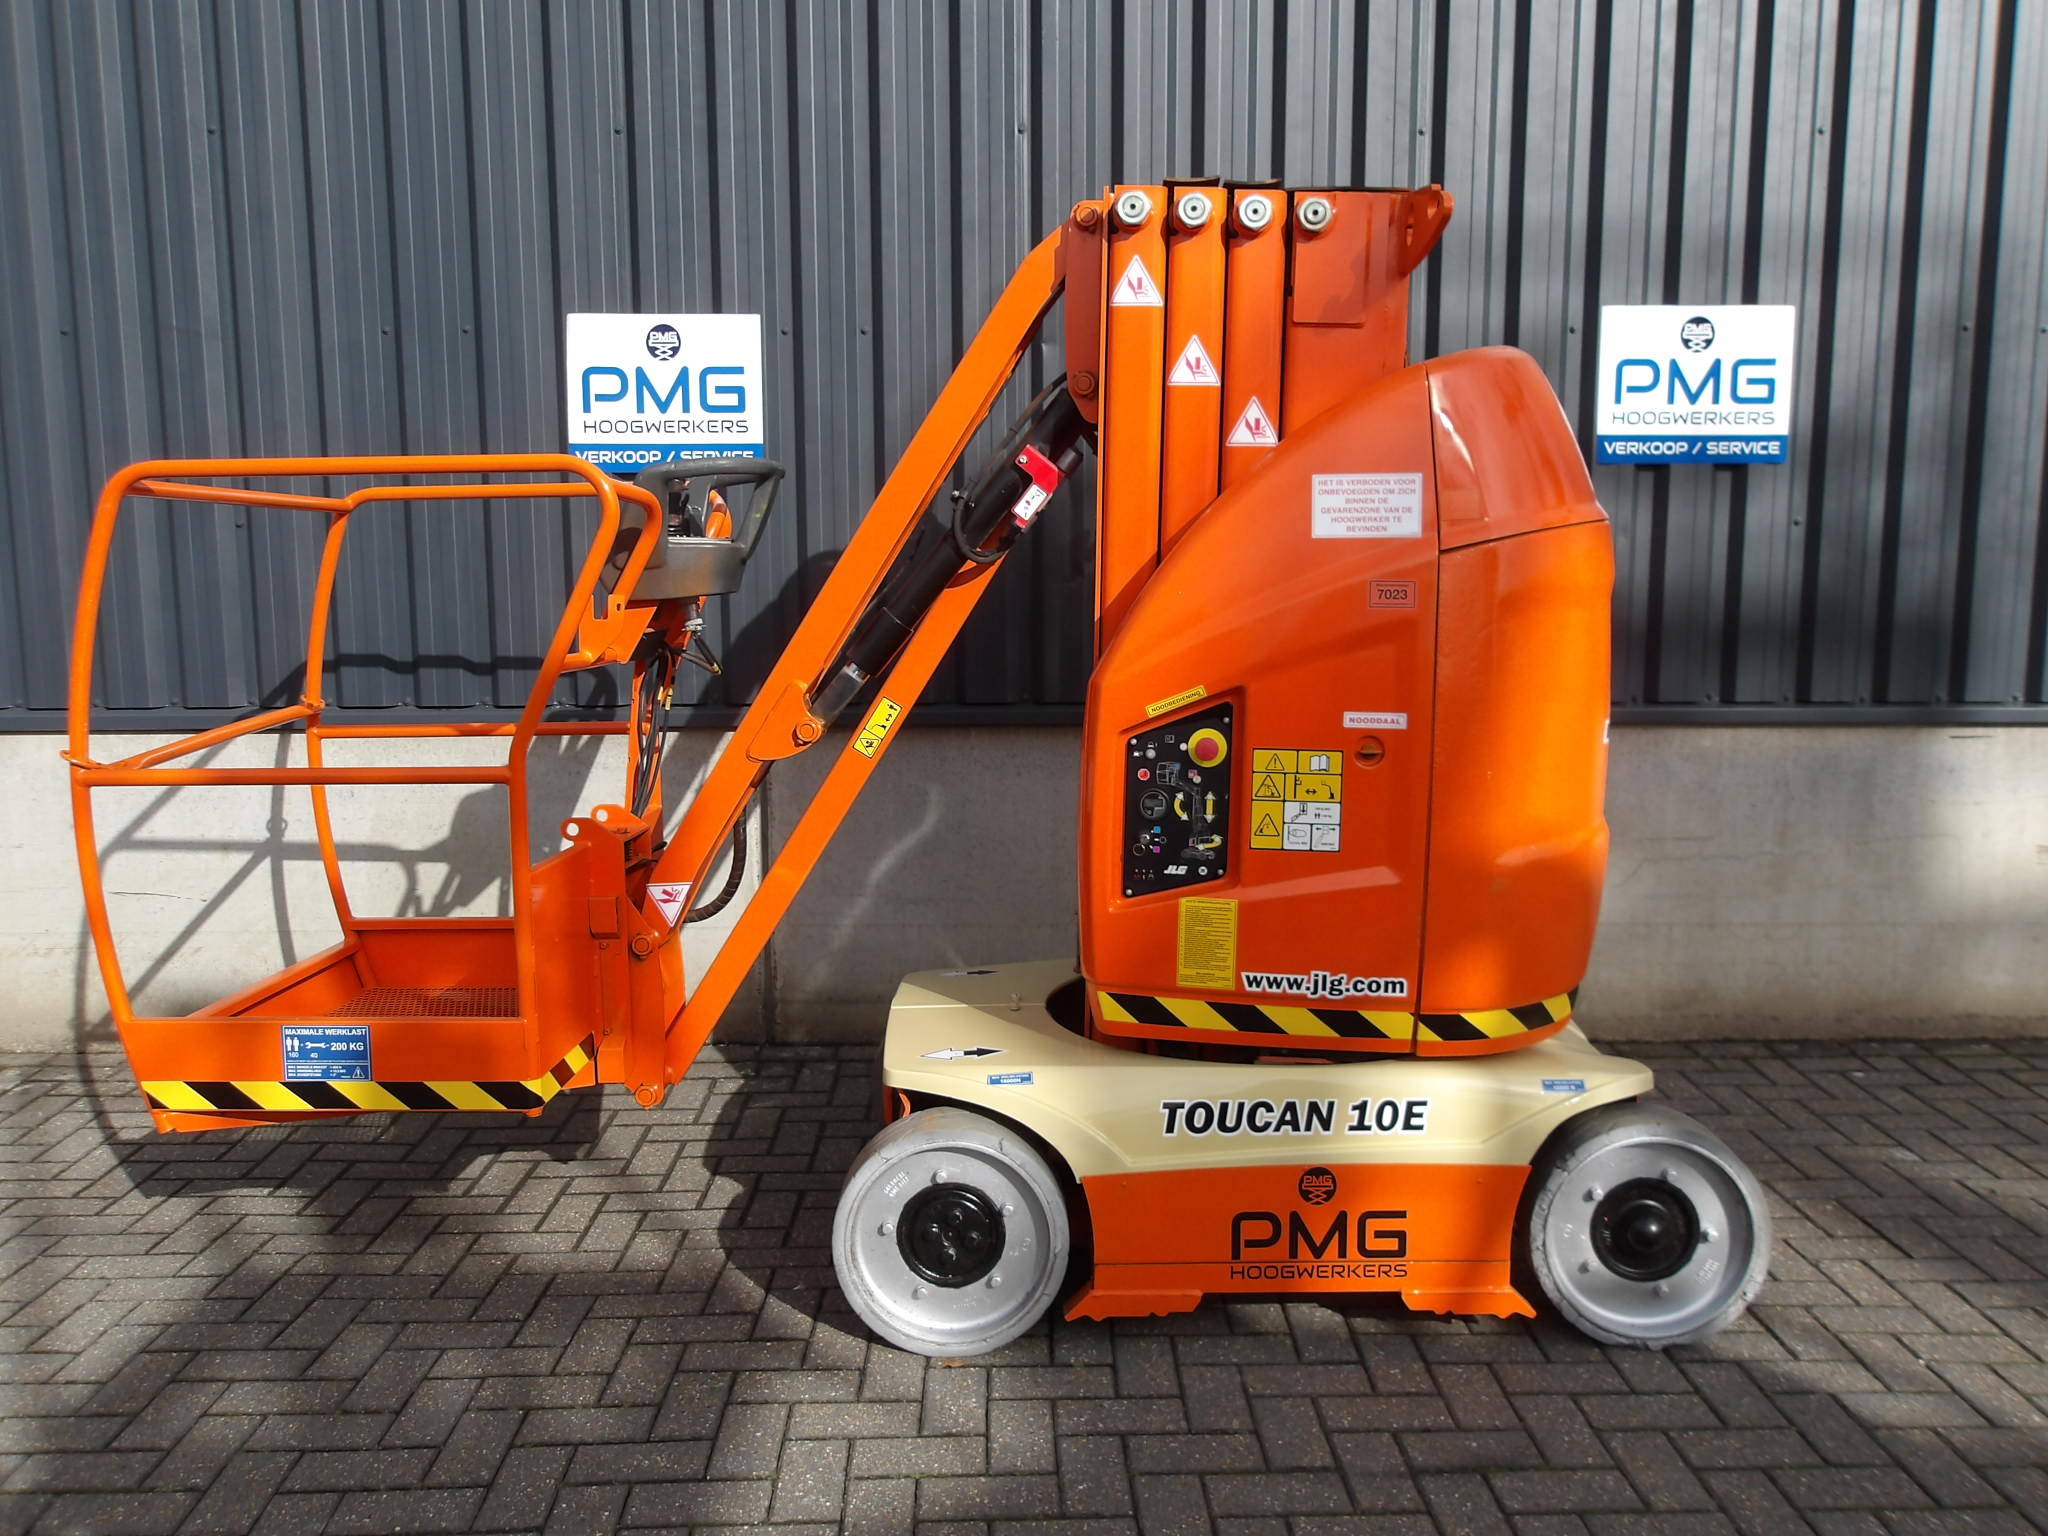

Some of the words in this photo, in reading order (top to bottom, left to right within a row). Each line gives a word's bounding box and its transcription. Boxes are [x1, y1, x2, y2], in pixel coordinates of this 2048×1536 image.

[649, 331, 678, 341] PMG
[1614, 358, 1777, 405] PMG
[582, 366, 746, 414] PMG
[1612, 411, 1775, 425] HOOGWERKERS
[583, 420, 749, 434] HOOGWERKERS
[1603, 441, 1688, 455] VERKOOP
[1692, 442, 1702, 454] /
[1706, 442, 1781, 455] SERVICE
[575, 450, 661, 464] VERKOOP
[667, 451, 675, 463] /
[1377, 589, 1408, 600] 7023
[1349, 717, 1401, 725] NOODDAAL
[1163, 865, 1188, 875] JLG
[1245, 973, 1405, 996] www.jlg.com
[285, 1028, 323, 1036] MAXIMALE
[325, 1028, 366, 1036] WERKLAST
[331, 1042, 347, 1051] 200
[349, 1042, 364, 1051] KG
[1162, 1100, 1336, 1134] TOUCAN
[1348, 1100, 1428, 1131] 10E
[1303, 1176, 1333, 1185] PMG
[1231, 1210, 1408, 1260] PMG
[1230, 1264, 1408, 1280] HOOGWERKERS
